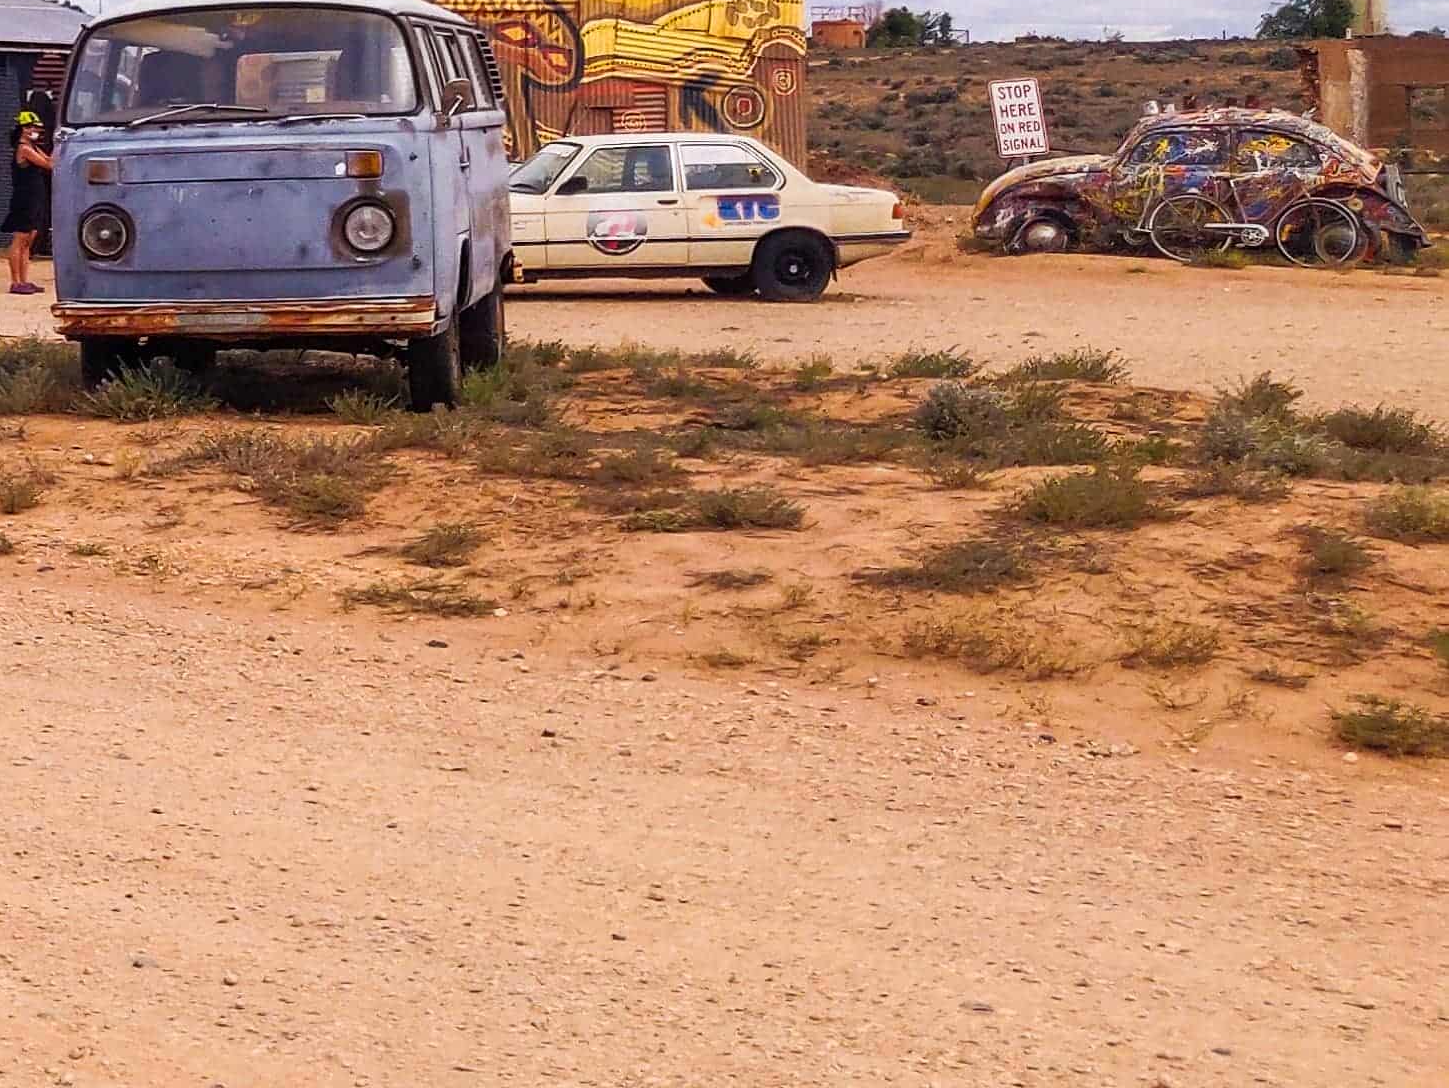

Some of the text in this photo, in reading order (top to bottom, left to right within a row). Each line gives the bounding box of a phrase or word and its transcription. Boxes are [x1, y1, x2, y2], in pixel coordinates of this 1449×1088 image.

[998, 85, 1031, 100] STOP
[999, 102, 1037, 118] HERE
[999, 120, 1041, 135] ON RED
[1003, 137, 1044, 152] SIGNAL
